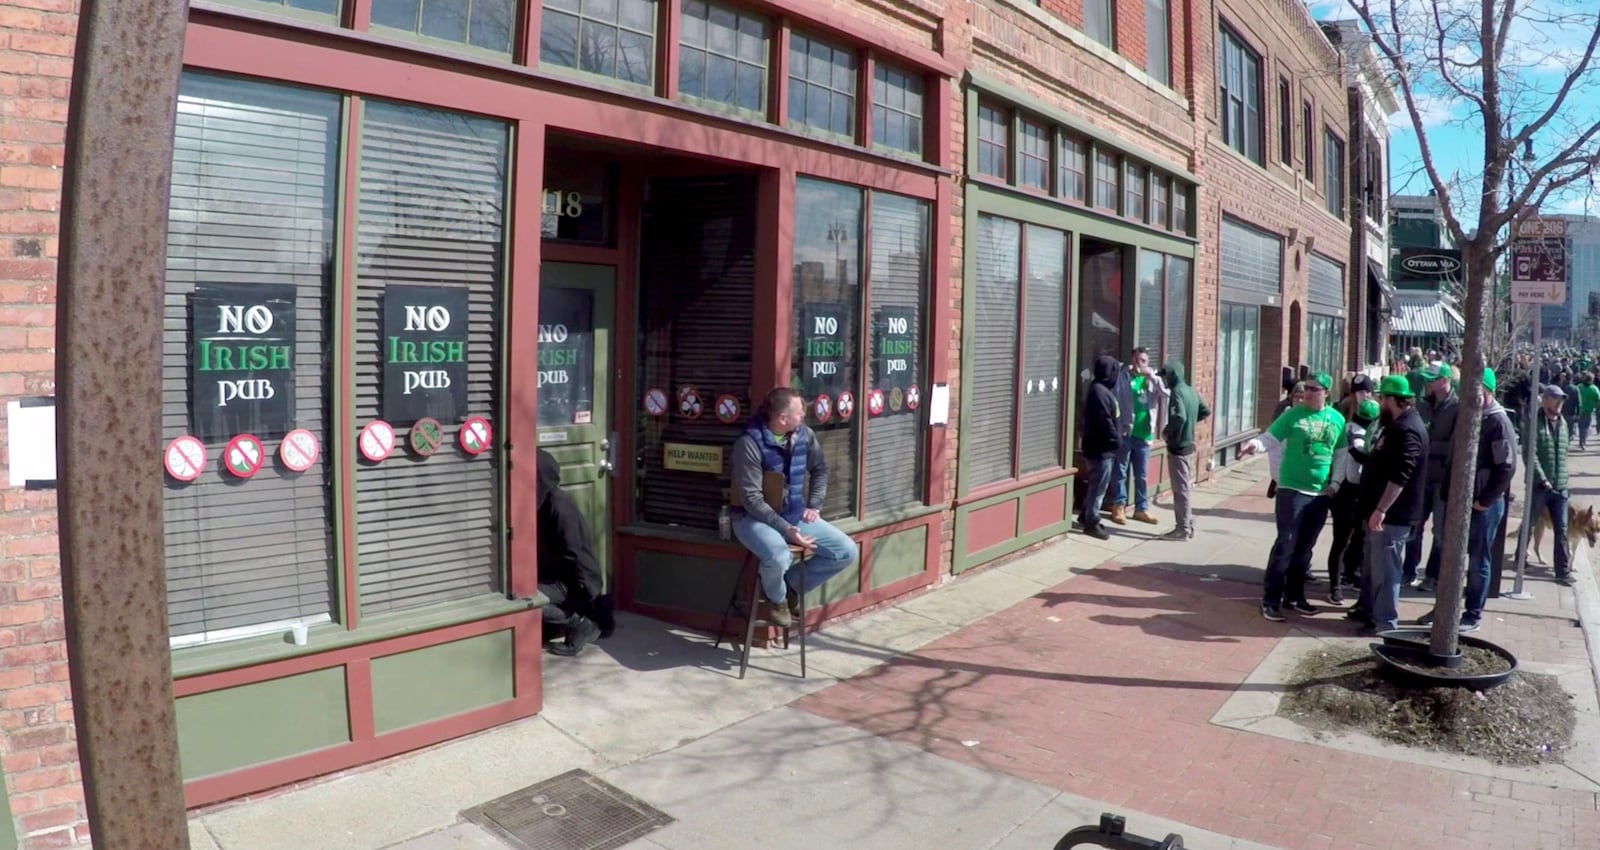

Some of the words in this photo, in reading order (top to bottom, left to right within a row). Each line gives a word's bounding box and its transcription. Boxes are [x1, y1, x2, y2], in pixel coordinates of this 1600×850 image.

[1407, 259, 1438, 268] OTTAVA
[1440, 259, 1455, 268] VIA
[217, 305, 274, 335] NO
[404, 305, 451, 332] NO
[814, 316, 838, 336] NO
[888, 317, 908, 334] NO
[538, 323, 568, 343] NO
[199, 341, 292, 371] IRISH
[388, 336, 465, 363] IRISH
[806, 337, 844, 357] IRISH
[881, 337, 913, 355] IRISH
[667, 449, 687, 458] HELP
[687, 451, 719, 461] WANTED
